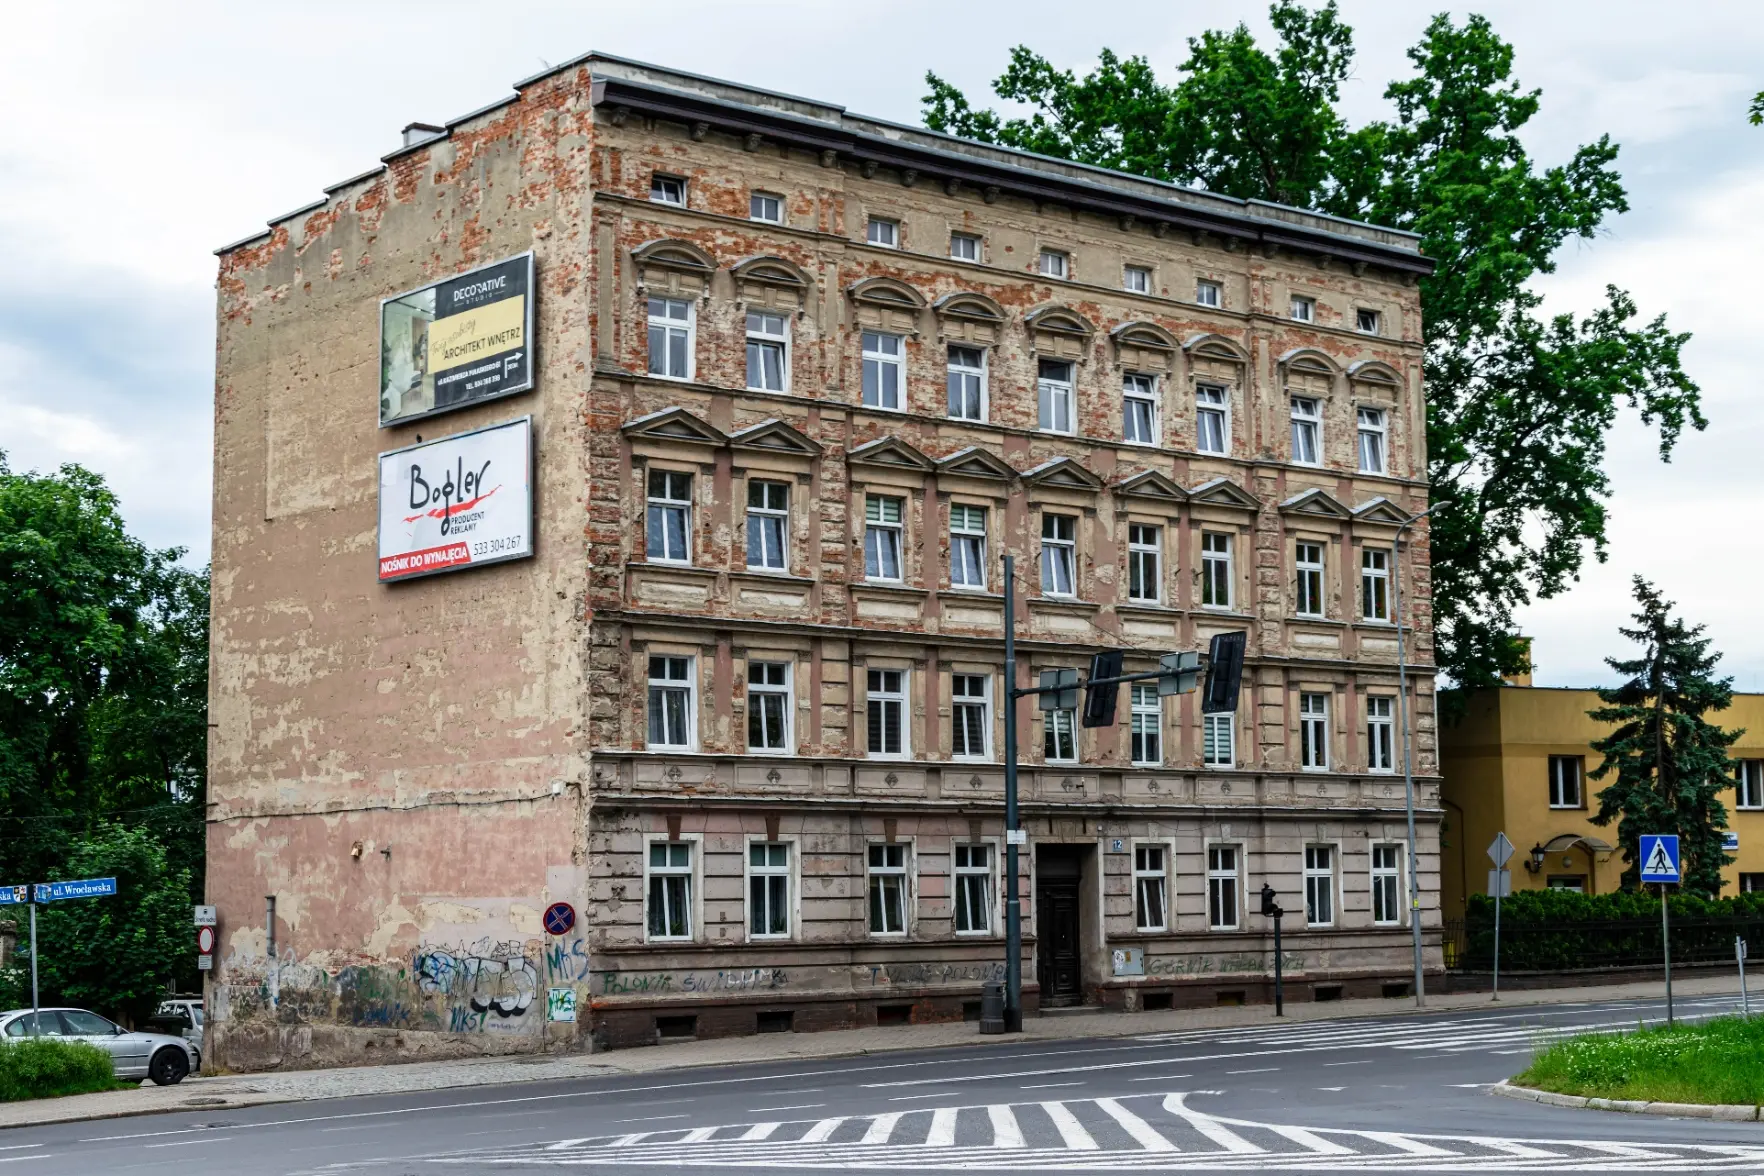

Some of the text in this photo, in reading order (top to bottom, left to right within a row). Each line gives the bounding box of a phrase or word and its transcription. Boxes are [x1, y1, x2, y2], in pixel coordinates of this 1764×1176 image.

[453, 275, 506, 302] DECORATIVE
[444, 326, 521, 360] ARCHITEKT WNĘTRZ
[450, 511, 485, 525] PRODUCENT
[450, 523, 477, 535] REKLAMY
[473, 535, 521, 556] 533 304 267
[381, 546, 468, 573] NOŚNIK DO WYNAJĘCIA
[1113, 840, 1122, 849] 12
[53, 887, 63, 896] ul.
[65, 883, 112, 895] Wrocławska
